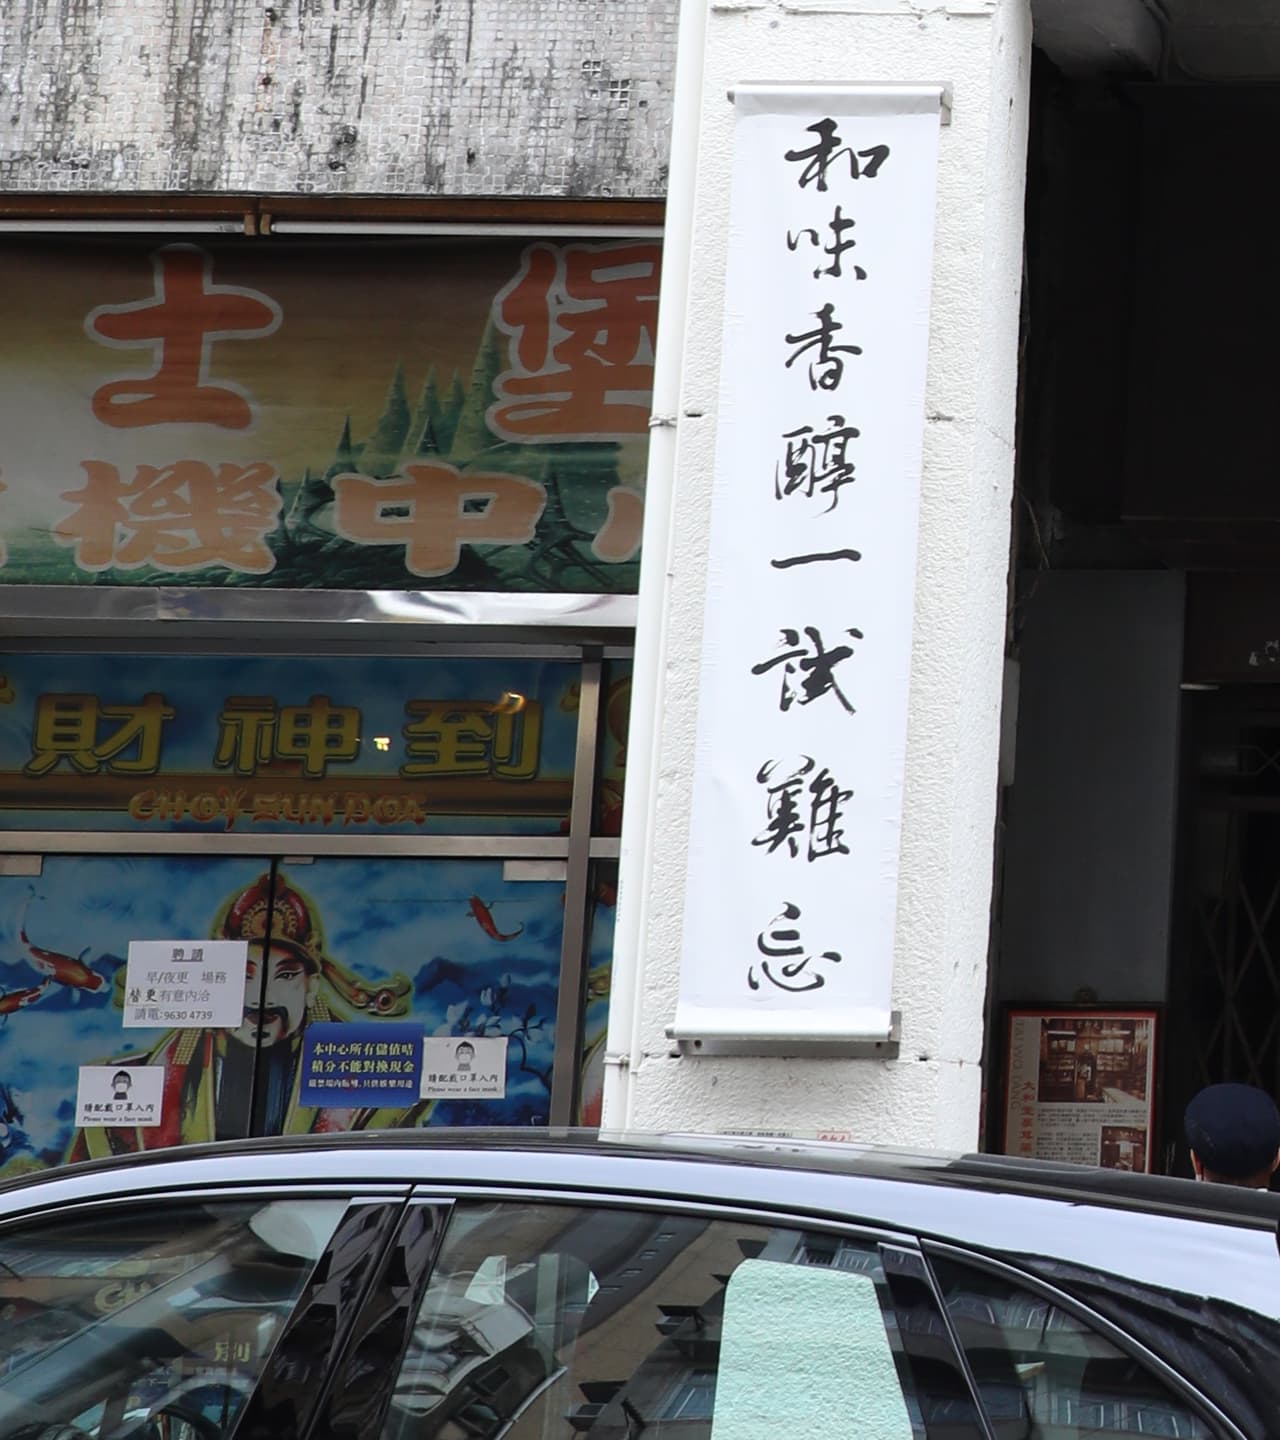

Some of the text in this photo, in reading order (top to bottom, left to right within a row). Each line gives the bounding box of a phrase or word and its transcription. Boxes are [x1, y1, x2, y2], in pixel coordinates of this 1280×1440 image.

[0, 455, 645, 578] 機中
[747, 117, 890, 992] 和味香醇一試難忘
[25, 692, 542, 780] 財神到
[128, 787, 248, 831] CHOY
[251, 791, 337, 825] SUN
[189, 1011, 214, 1020] 4739
